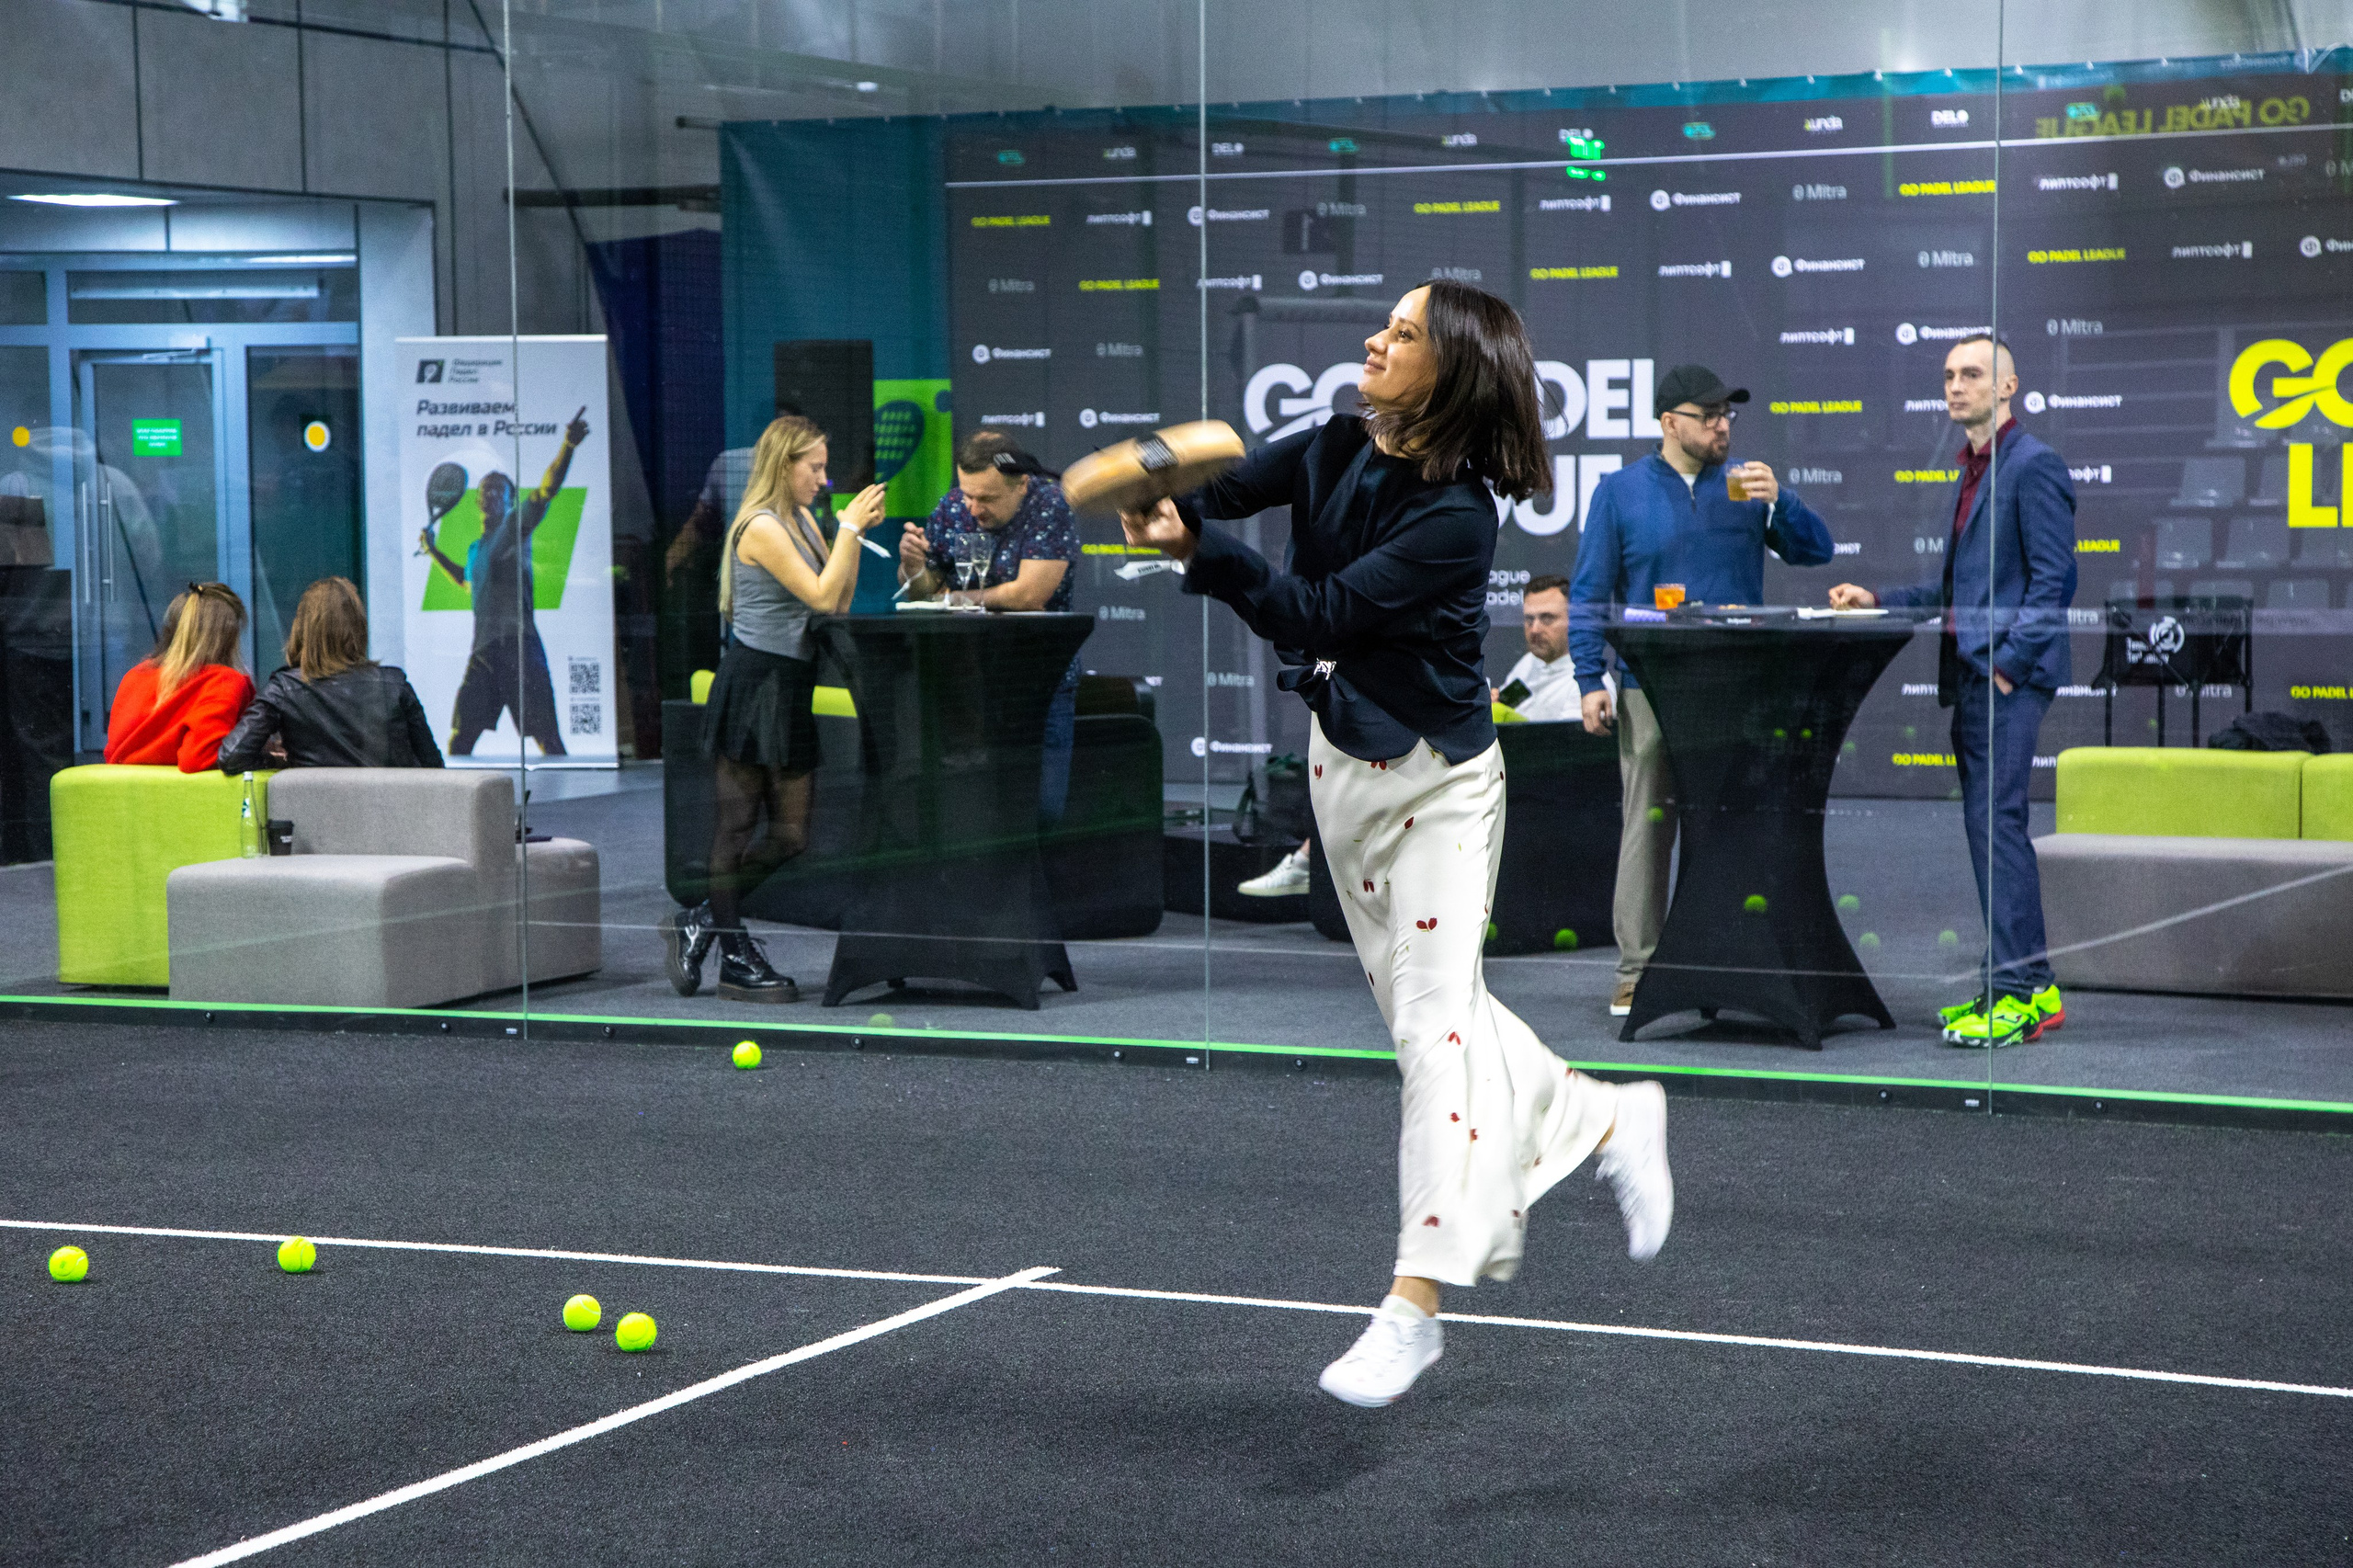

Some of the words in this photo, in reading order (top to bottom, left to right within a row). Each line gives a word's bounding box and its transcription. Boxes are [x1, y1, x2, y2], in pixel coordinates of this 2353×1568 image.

[1806, 184, 1847, 199] Mitra
[1933, 250, 1973, 267] Mitra
[2062, 318, 2103, 335] Mitra
[416, 399, 516, 415] Развиваем
[416, 424, 472, 438] падел
[477, 424, 488, 436] в
[1804, 468, 1842, 483] Mitra
